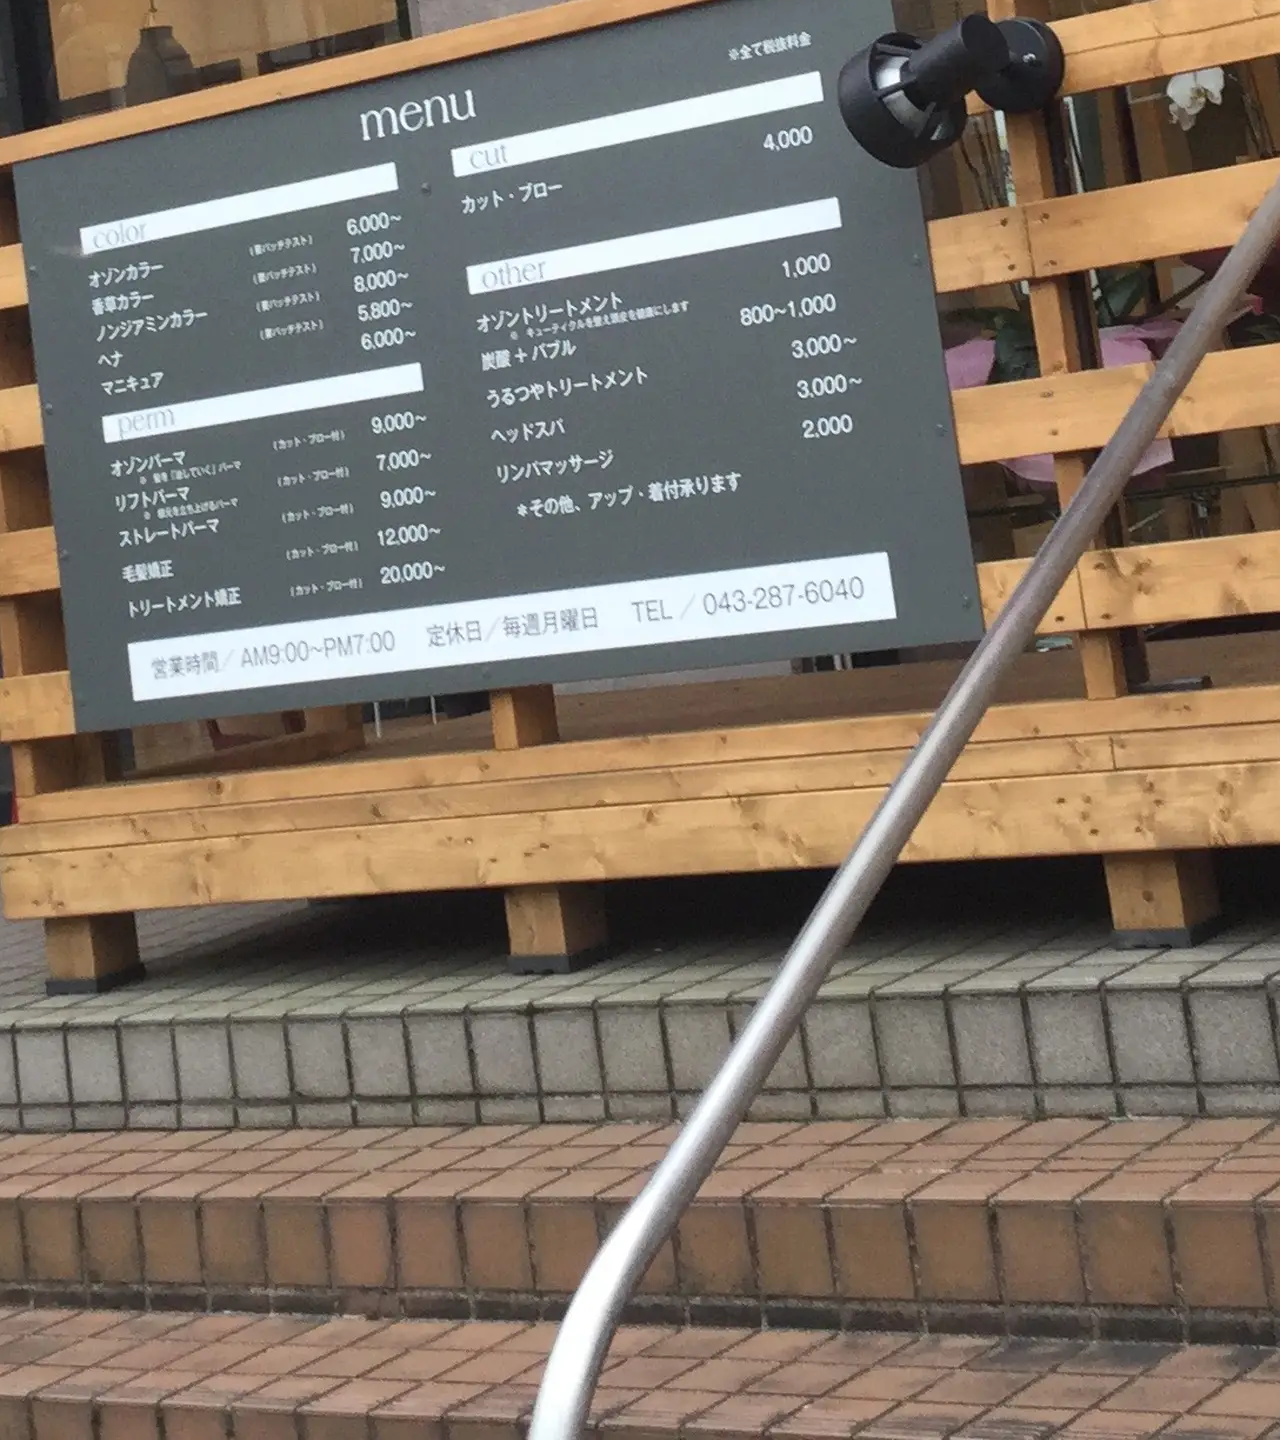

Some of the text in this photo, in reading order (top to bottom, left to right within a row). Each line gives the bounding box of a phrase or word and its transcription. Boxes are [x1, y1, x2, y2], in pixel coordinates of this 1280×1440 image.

[360, 89, 477, 141] menu
[763, 126, 813, 152] 4,000
[469, 144, 508, 170] cut
[93, 222, 147, 250] color
[88, 261, 164, 288] オゾンカラー
[482, 261, 546, 289] other
[476, 253, 831, 334] オゾントリートメント 1,000
[96, 308, 208, 342] ノンジアミンカラー
[101, 372, 164, 396] マニキュア
[486, 366, 649, 408] うるつやトリートメント
[118, 408, 176, 439] perm
[802, 414, 853, 439] 2,000
[110, 451, 186, 477] オゾンパーマ
[115, 487, 190, 512] リフトパーマ
[119, 519, 220, 547] ストレートパーマ
[703, 576, 865, 616] 043-287-6040
